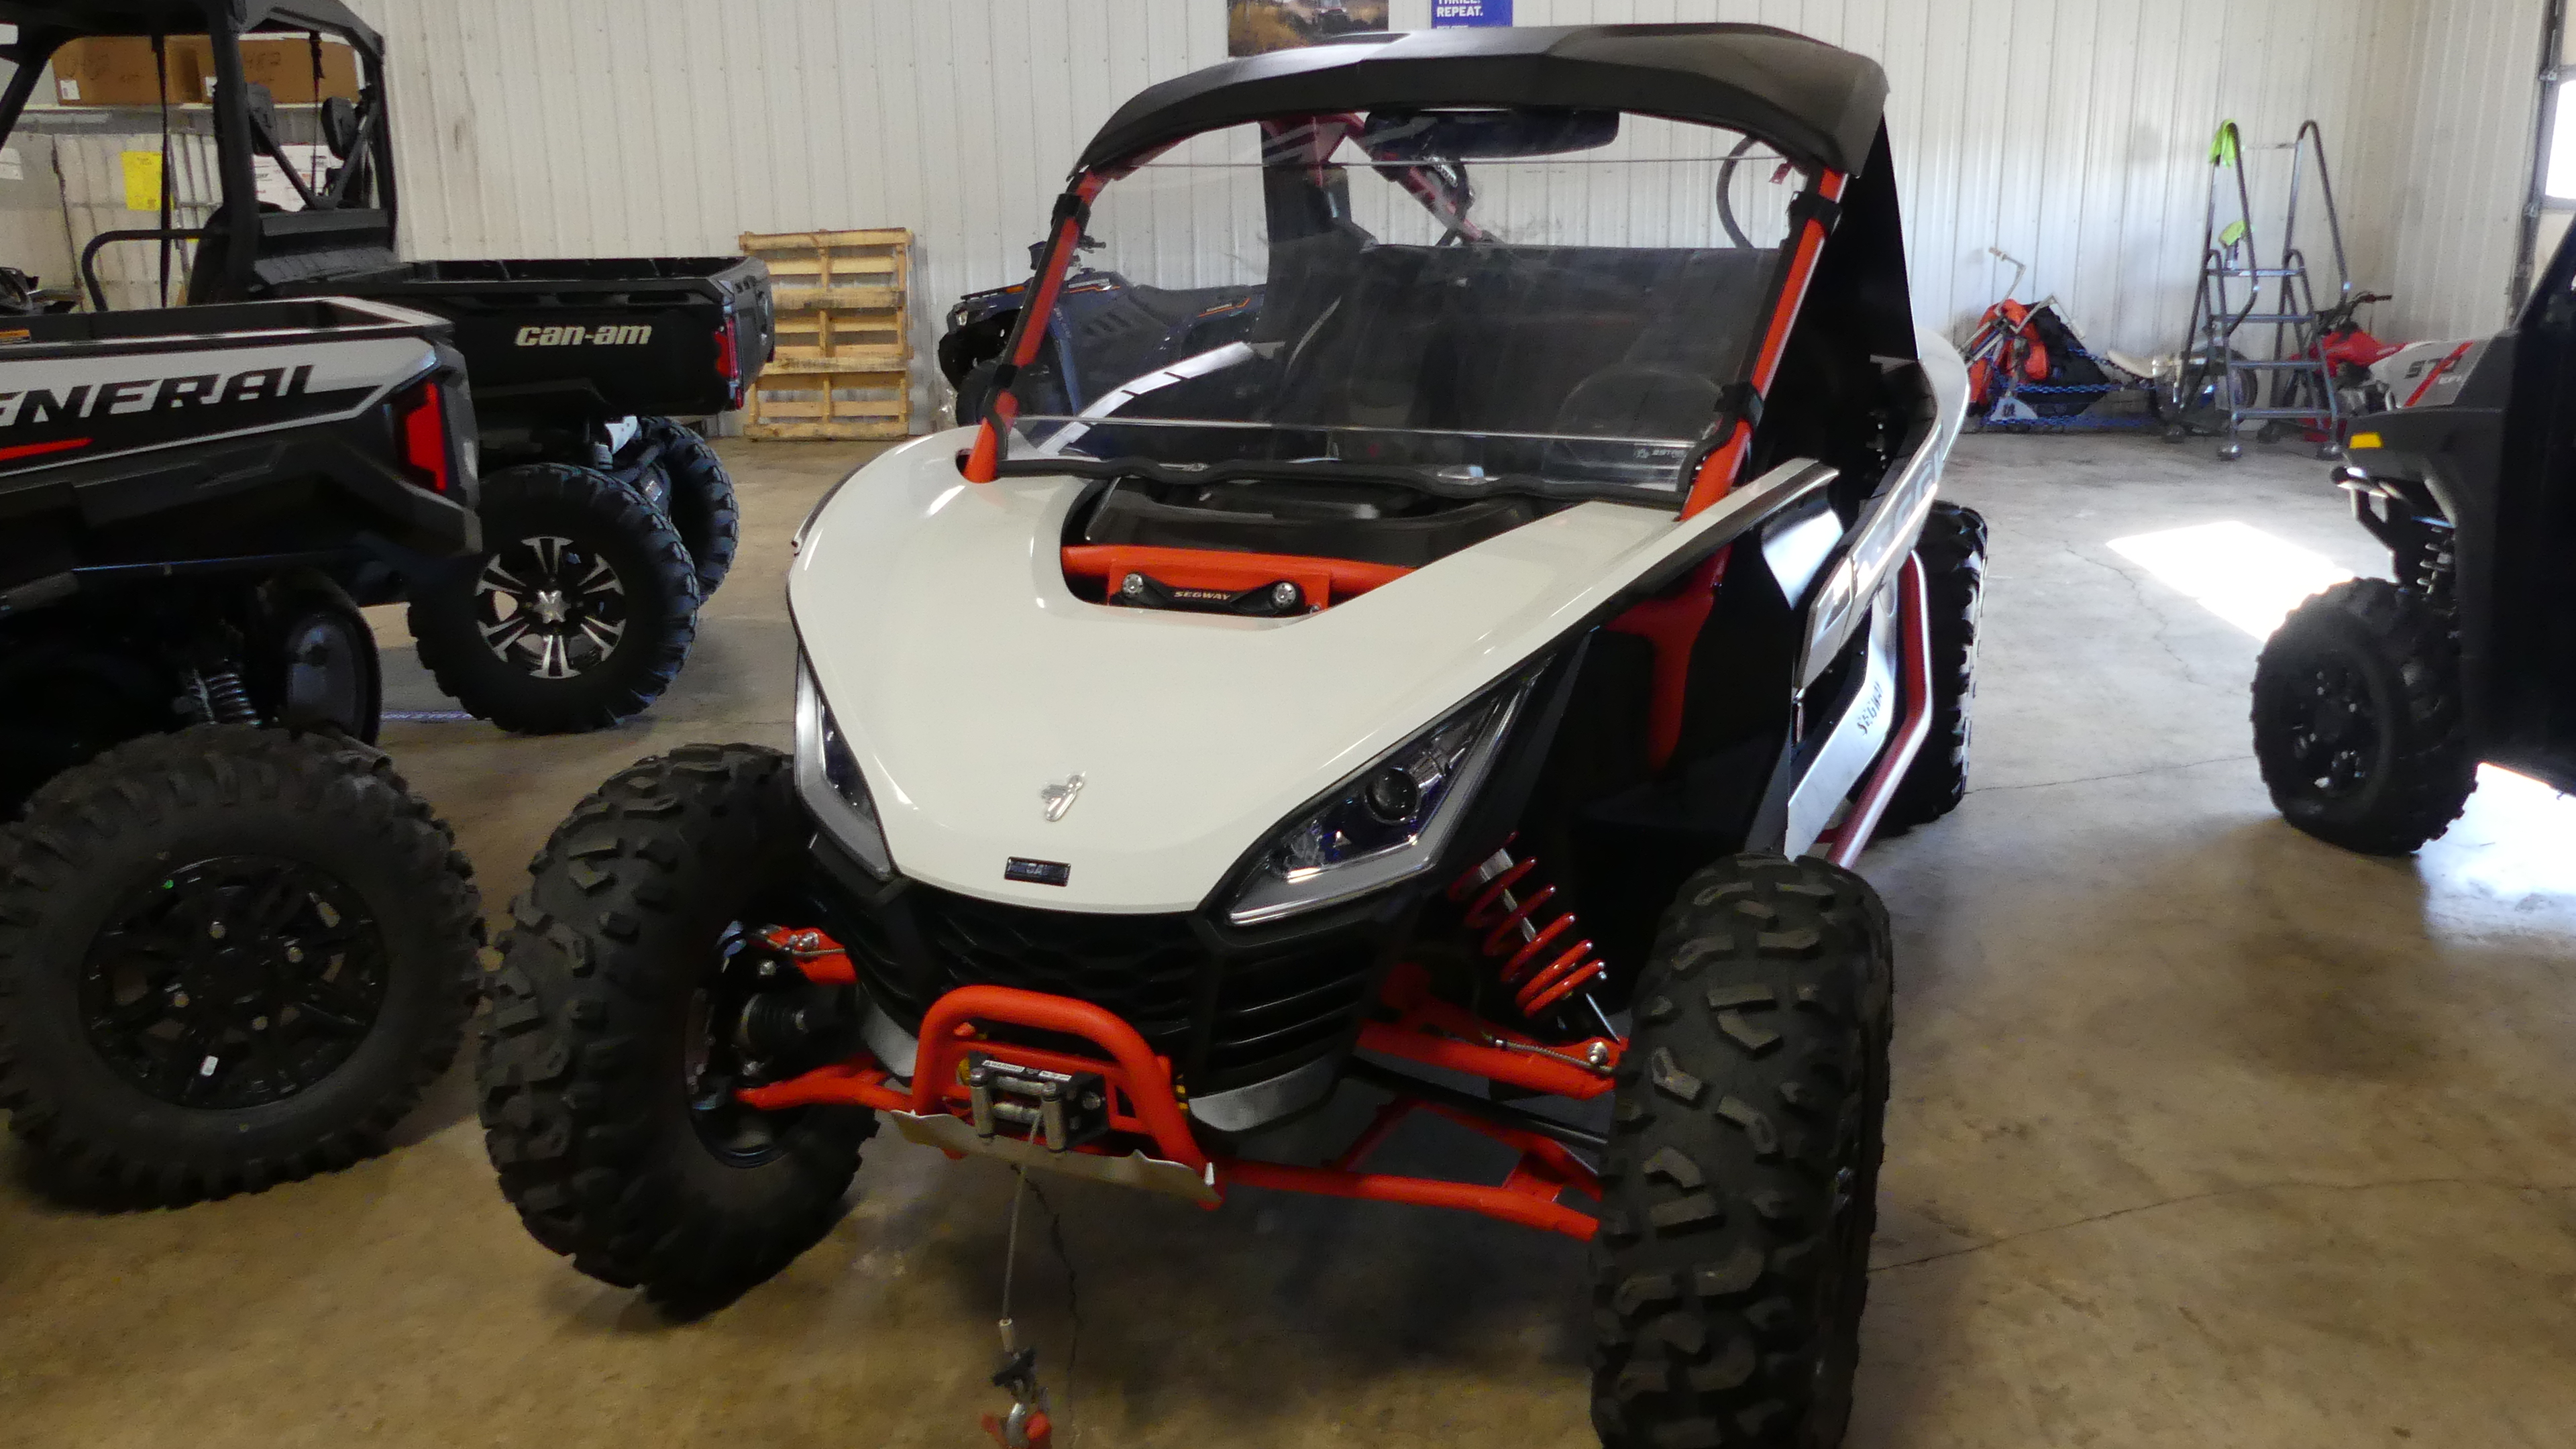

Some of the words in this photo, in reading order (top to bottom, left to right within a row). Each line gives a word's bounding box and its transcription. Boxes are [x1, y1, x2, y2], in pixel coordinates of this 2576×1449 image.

[1436, 5, 1483, 17] REPEAT.
[515, 325, 652, 346] can-am
[1174, 590, 1230, 600] SEGWAY
